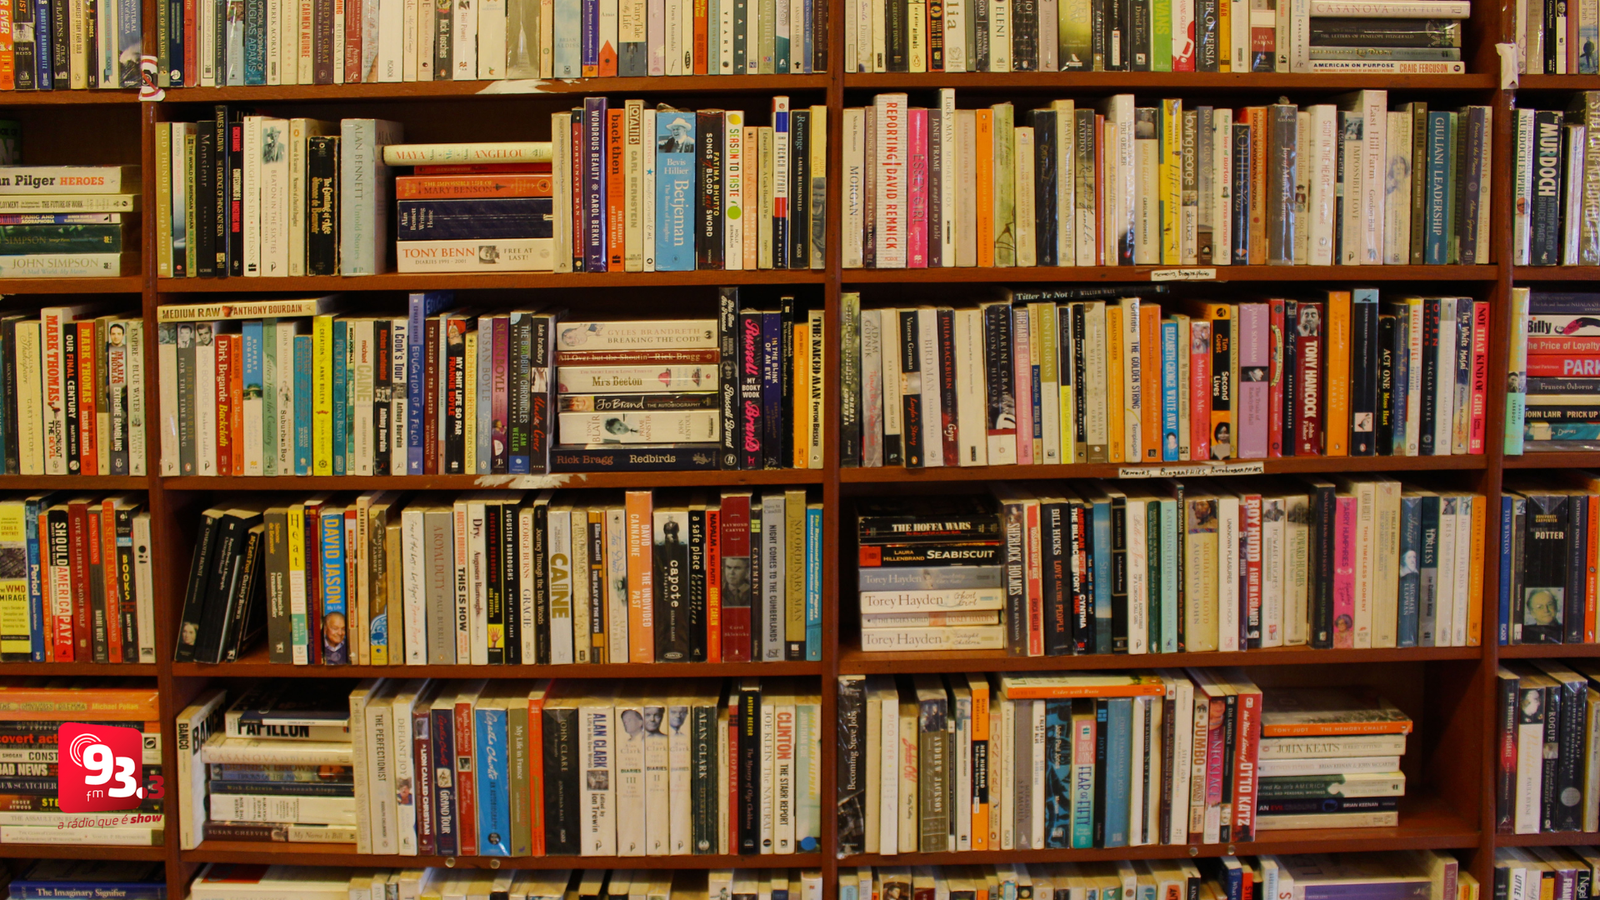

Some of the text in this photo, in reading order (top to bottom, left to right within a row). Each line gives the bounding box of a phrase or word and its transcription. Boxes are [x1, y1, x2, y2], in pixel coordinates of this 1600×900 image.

[439, 19, 448, 58] Nick Tosches
[996, 6, 1005, 38] ELENI
[1400, 64, 1417, 73] CRAIG
[1418, 63, 1448, 72] FERGUSON
[591, 110, 600, 150] WONDROUS
[629, 106, 640, 144] LOYALTIES
[1368, 104, 1379, 179] East Hill Farm
[355, 124, 363, 200] ALAN BENNETT
[396, 149, 526, 160] MAYA ANGELOU
[611, 114, 622, 175] back then
[729, 129, 739, 197] SEASON TO TASTE
[1538, 123, 1558, 196] MURDOCH
[15, 175, 104, 188] Pilger HEROES
[591, 153, 599, 180] BEAUTY
[886, 102, 898, 249] REPORTING DAVID REMNICK
[1433, 117, 1445, 235] GIULIANI LEADERSHIP
[670, 180, 689, 247] Betjeman
[592, 220, 600, 246] BERKIN
[12, 258, 99, 269] JOHN SIMPSON
[402, 247, 475, 258] TONY BENN
[163, 304, 302, 319] MEDIUM RAW ANTHONY BOURDAIN
[46, 315, 59, 401] MARK THOMAS
[66, 335, 76, 418] OUR FINAL CENTURY
[456, 357, 462, 369] MY
[812, 317, 821, 399] THE NAKED MAN
[1131, 342, 1140, 409] THE GOLDEN STRING
[1474, 308, 1486, 417] NOT THAT KIND OF GIRL
[216, 340, 228, 446] Dirk Bogarde Backcloth
[1213, 371, 1229, 400] Second Lives
[1305, 340, 1317, 418] TONY HANCOCK
[455, 408, 462, 419] SO
[724, 384, 735, 448] Russell Brand
[557, 454, 676, 465] Rick Bragg Redbirds
[692, 524, 701, 543] safe
[769, 525, 777, 545] NIGHT
[892, 522, 971, 532] THE HOFFA WARS
[1051, 509, 1061, 555] BILL HICKS
[1247, 500, 1260, 562] ROY HUDD
[1535, 531, 1564, 540] POTTER
[324, 519, 341, 604] DAVID JASON
[690, 546, 701, 570] place
[769, 546, 777, 568] COMES
[927, 550, 995, 559] SEABISCUIT
[1007, 523, 1022, 596] SHERLOCK HOLMES
[54, 522, 71, 645] SHOULD AMERICA PAY?
[667, 560, 681, 608] capote
[769, 571, 776, 579] TO
[459, 594, 466, 604] IS
[865, 595, 944, 608] Torey Hayden
[459, 607, 467, 631] HOW
[375, 715, 386, 782] THE PERFECTIONIST
[593, 713, 607, 768] ALAN CLARK
[1194, 722, 1207, 765] JUMBO
[17, 764, 47, 776] NEWS
[777, 712, 792, 826] CLINTON THE STARR REPORT
[1077, 766, 1091, 790] FEAR
[1237, 762, 1253, 826] OTTO KATZ
[1076, 801, 1091, 826] FIFTY
[36, 888, 126, 898] The Imaginary Signifier
